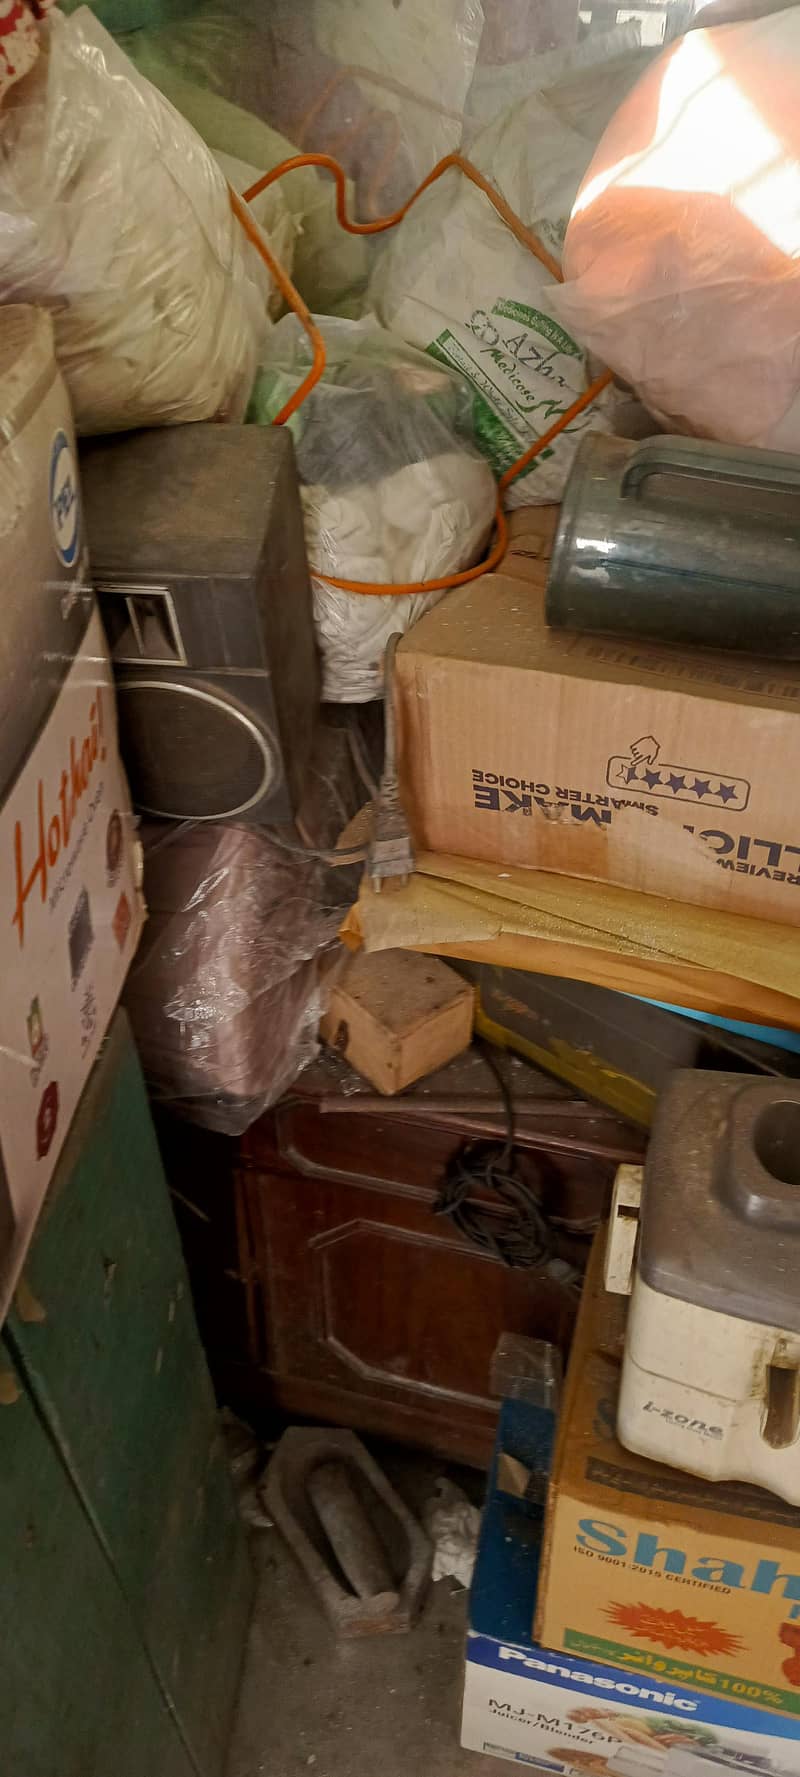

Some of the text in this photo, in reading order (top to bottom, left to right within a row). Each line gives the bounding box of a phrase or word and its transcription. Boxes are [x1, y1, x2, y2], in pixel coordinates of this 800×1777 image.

[502, 332, 567, 388] Azh
[471, 768, 550, 795] CHOICE
[574, 1546, 732, 1595] ISO 9001:2015 CERTIFIED
[498, 1645, 699, 1712] Panasonic
[489, 1709, 595, 1745] Juicer/Blender
